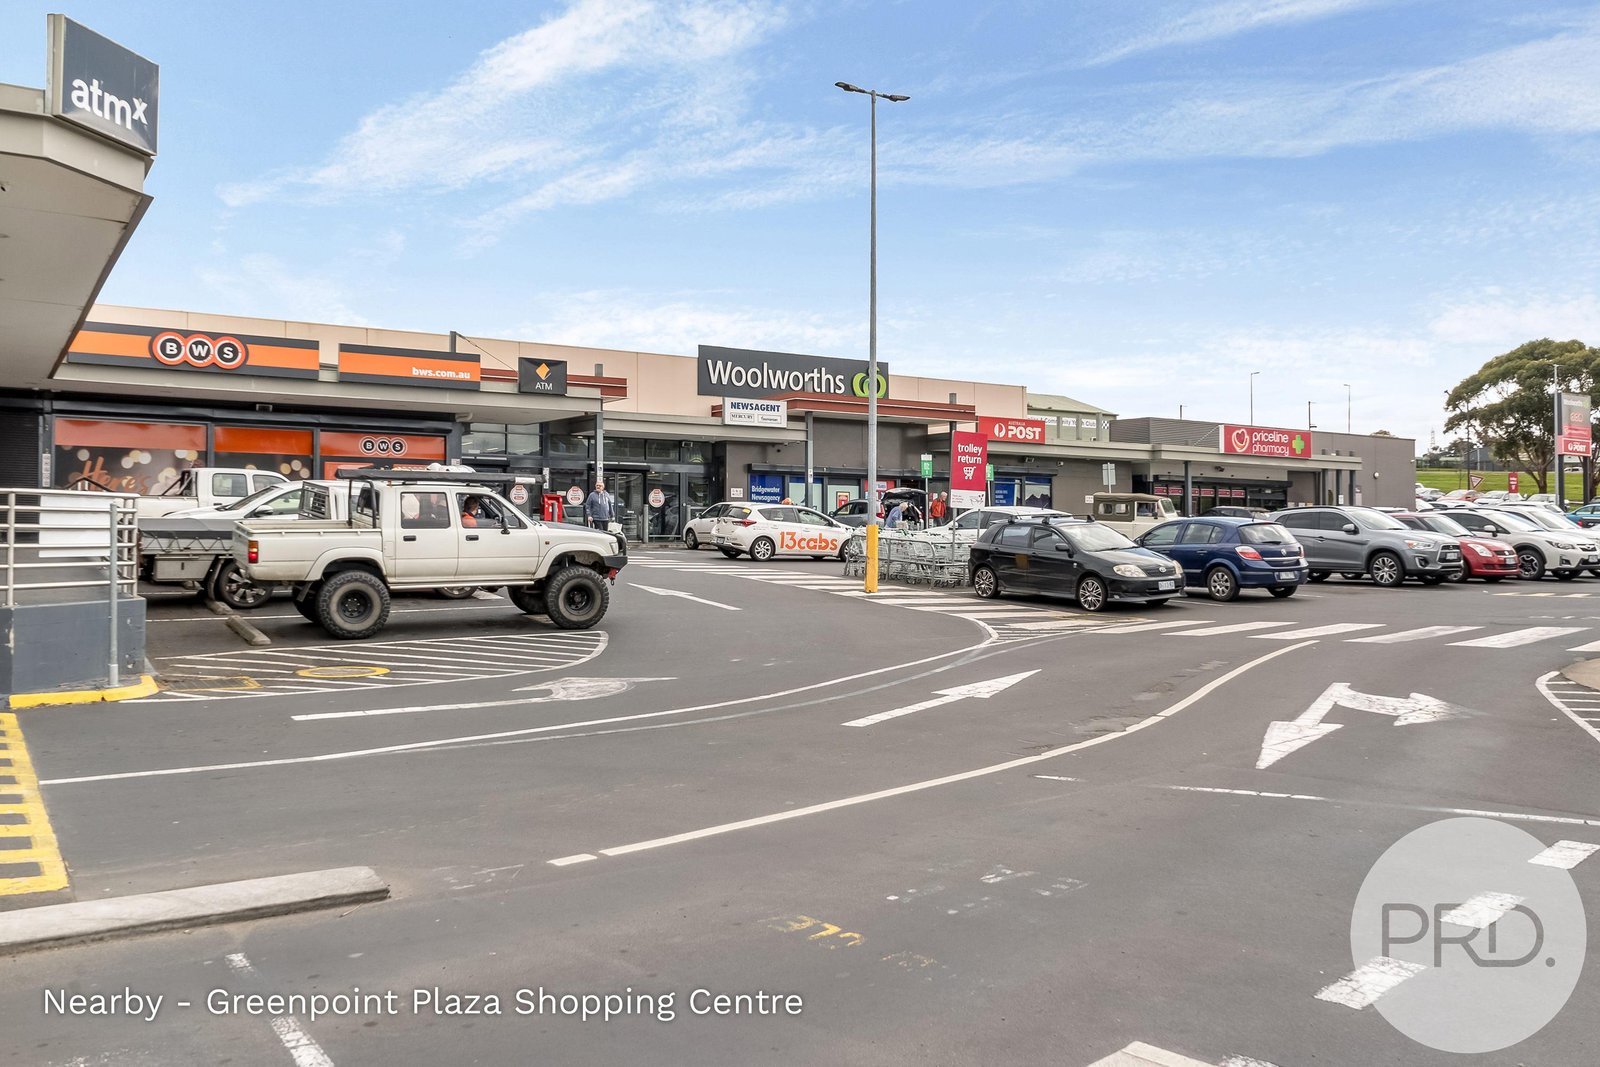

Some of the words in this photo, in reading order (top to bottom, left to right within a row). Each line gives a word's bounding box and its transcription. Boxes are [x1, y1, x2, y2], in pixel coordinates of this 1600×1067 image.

[165, 341, 234, 359] BWS
[412, 367, 471, 379] bws.com.au
[706, 359, 845, 394] Woolworths
[535, 381, 553, 391] ATM
[730, 401, 781, 412] NEWSAGENT
[1008, 425, 1042, 440] POST
[1252, 431, 1289, 443] priceline
[957, 443, 983, 456] trolley
[1252, 442, 1289, 456] pharmacy
[957, 455, 982, 464] return
[751, 485, 781, 494] Bridgewater
[751, 493, 780, 503] Newsagency
[780, 531, 838, 551] 13cabs
